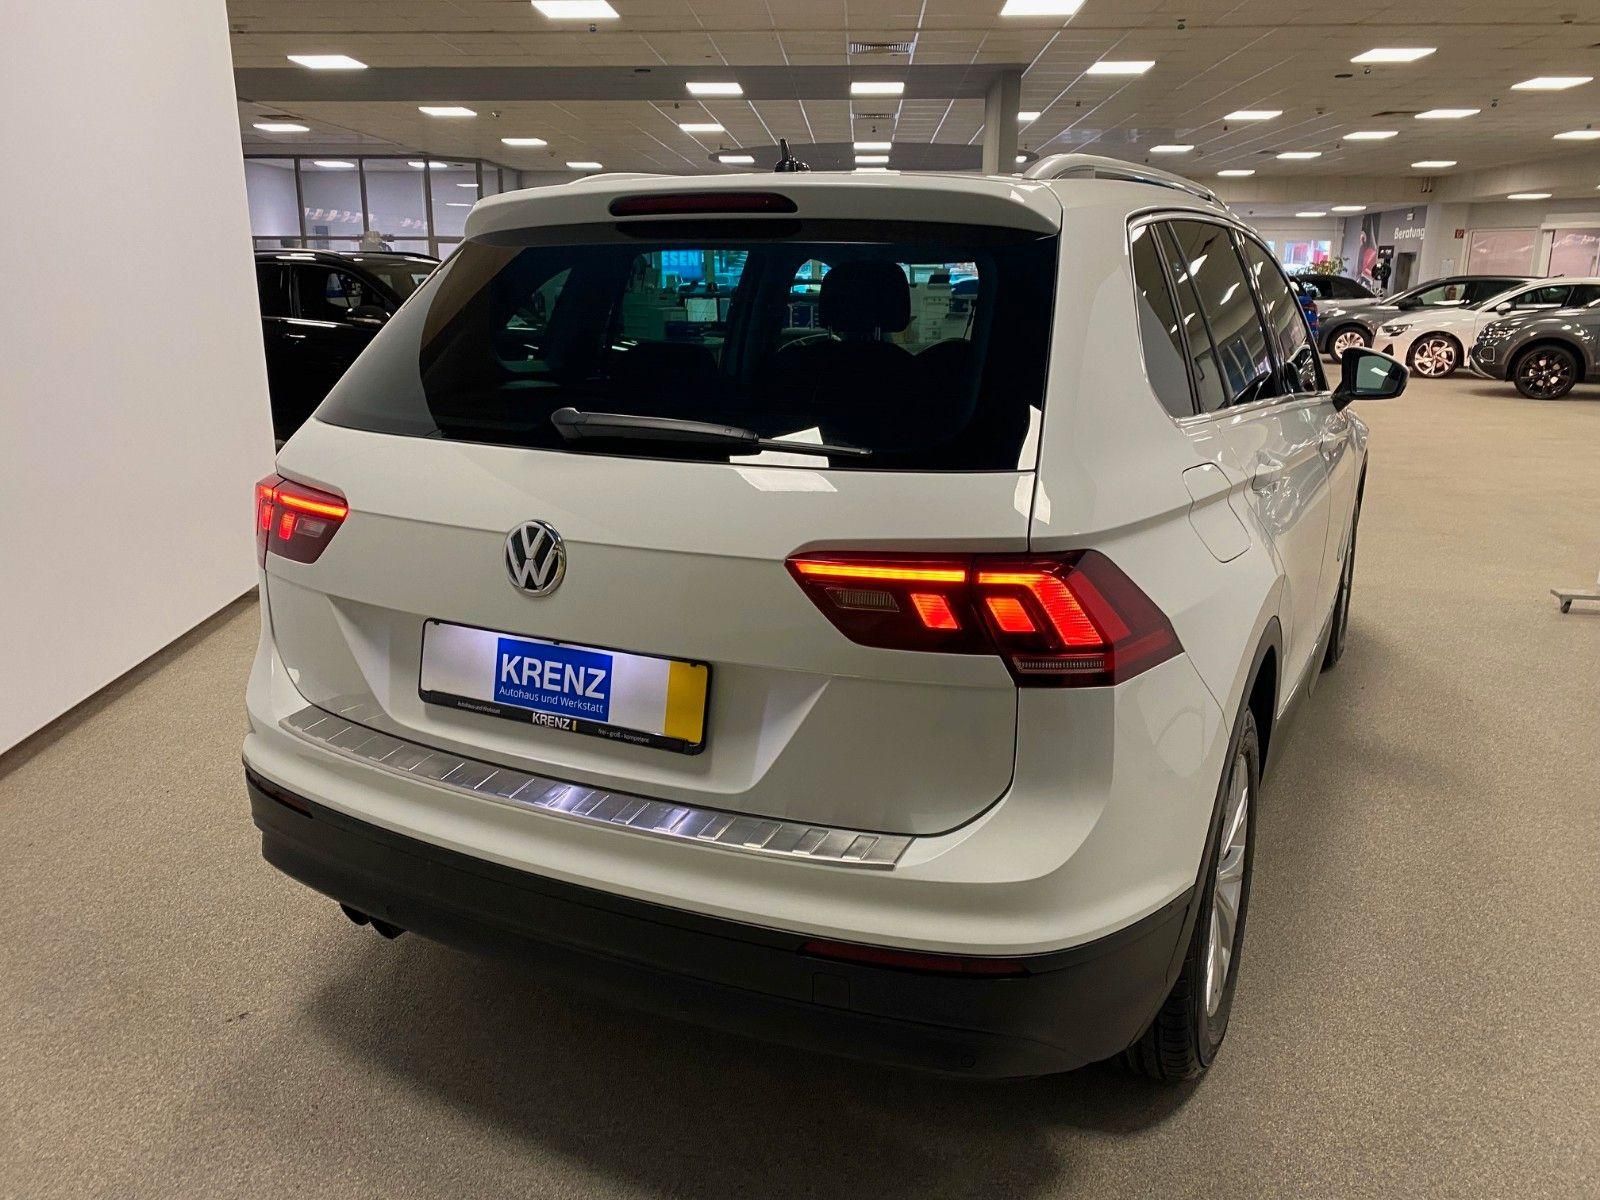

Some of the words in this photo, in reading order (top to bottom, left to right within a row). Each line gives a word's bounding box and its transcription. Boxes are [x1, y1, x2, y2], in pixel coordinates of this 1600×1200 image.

[1394, 227, 1425, 240] Beratung
[501, 653, 606, 699] KRENZ
[499, 686, 539, 702] Autohaus
[541, 694, 558, 705] und
[560, 696, 604, 714] Werkstatt
[532, 712, 570, 730] KRENZ
